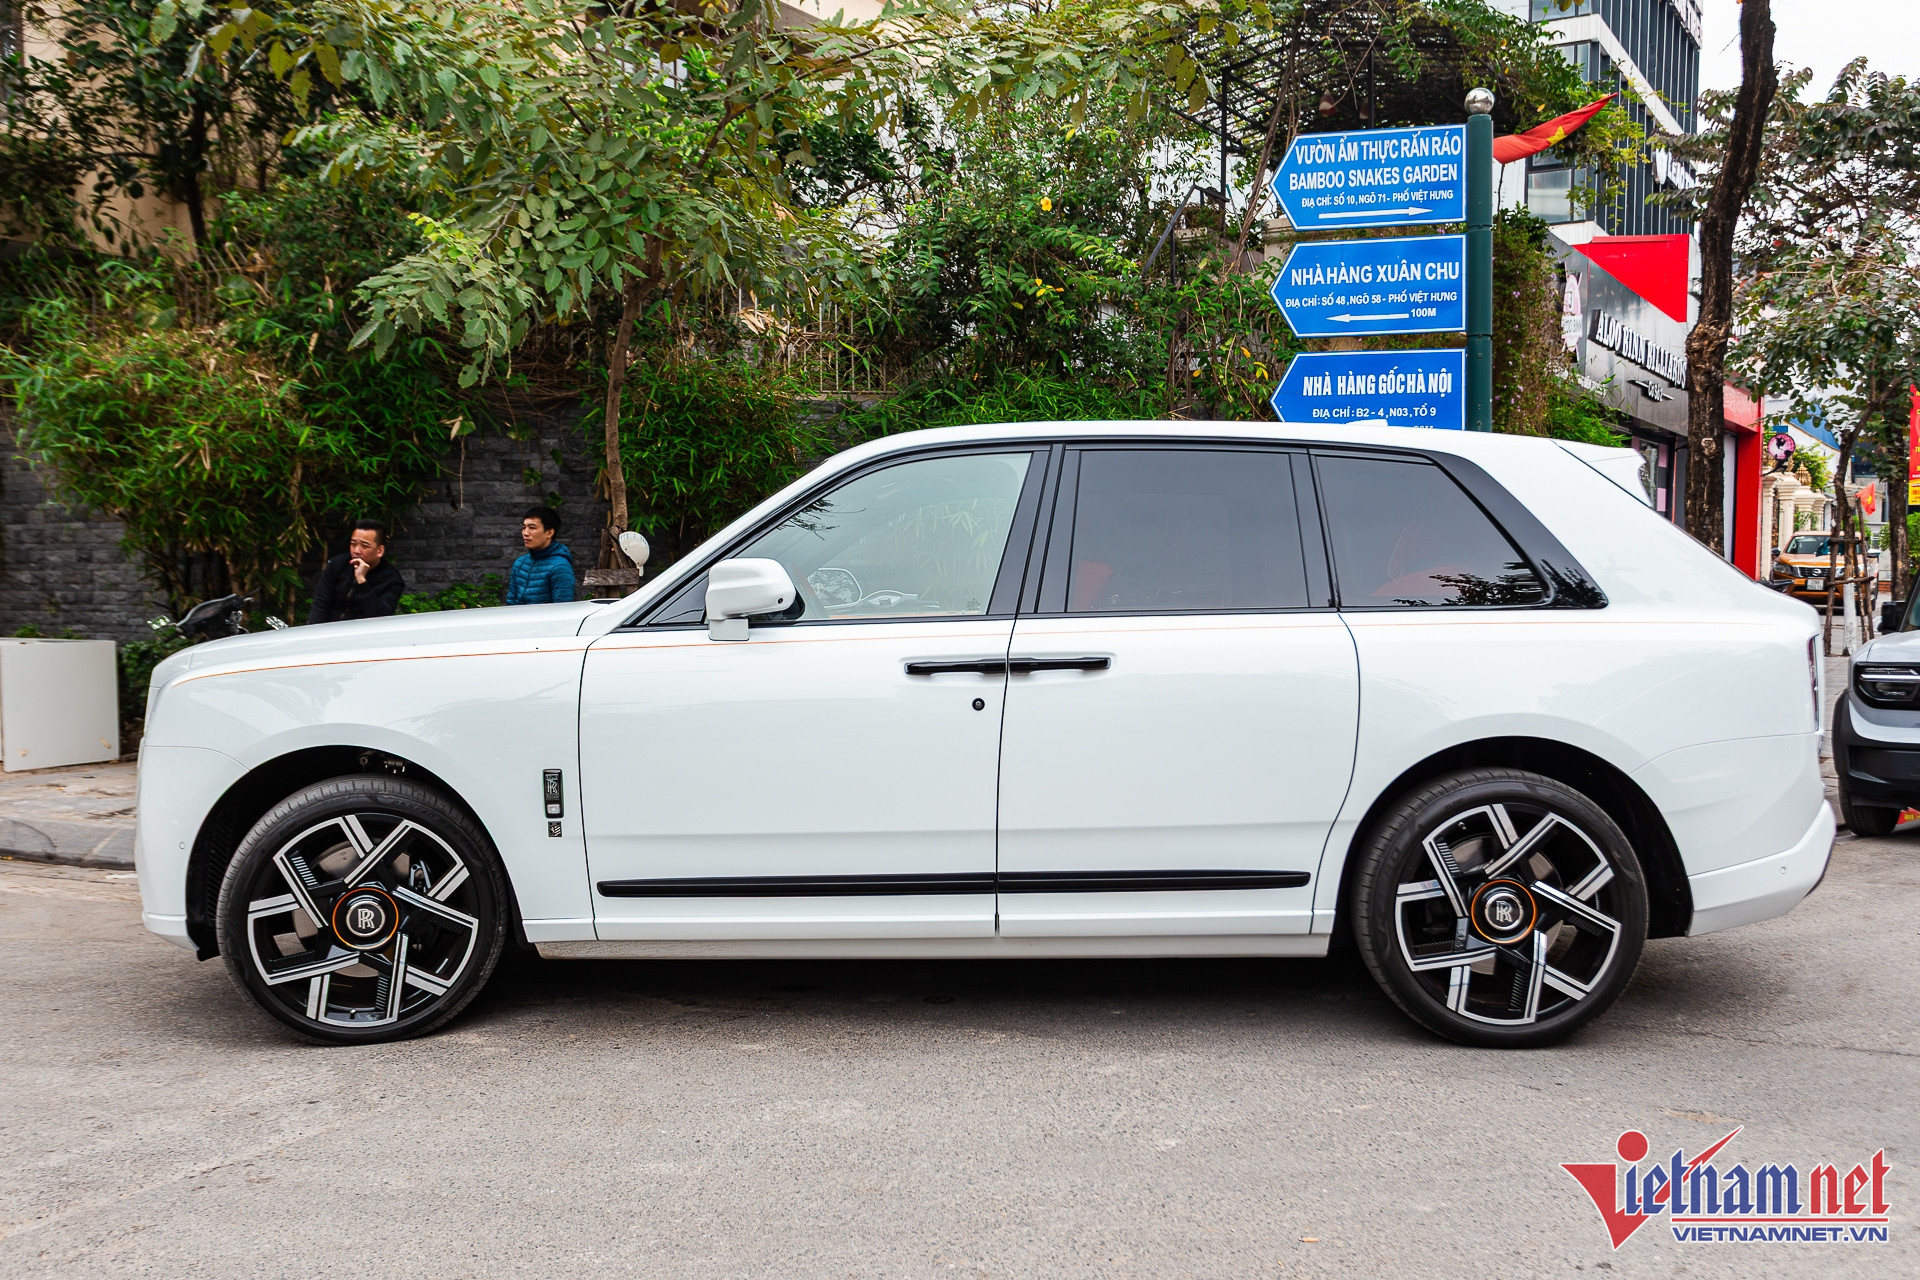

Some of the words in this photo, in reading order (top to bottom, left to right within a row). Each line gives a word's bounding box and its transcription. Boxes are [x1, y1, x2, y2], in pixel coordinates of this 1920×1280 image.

[1295, 139, 1335, 165] VƯỜN
[1338, 135, 1359, 162] ẨM
[1361, 139, 1399, 164] THỰC
[1401, 131, 1429, 158] RẮN
[1432, 131, 1461, 156] RÁO
[1289, 170, 1345, 191] BAMBOO
[1348, 166, 1400, 187] SNAKES
[1403, 163, 1458, 184] GARDEN
[1333, 191, 1345, 206] SỐ
[1392, 187, 1410, 202] PHỐ
[1411, 189, 1428, 203] VIỆT
[1429, 189, 1454, 200] HƯNG
[1291, 263, 1325, 286] NHÀ
[1326, 261, 1373, 285] HÀNG
[1376, 259, 1422, 283] XUÂN
[1424, 261, 1460, 281] CHU
[1321, 292, 1334, 306] SỐ
[1388, 289, 1407, 303] PHỐ
[1409, 290, 1429, 304] VIỆT
[1430, 291, 1457, 302] HƯNG
[1410, 307, 1437, 318] 100M
[1596, 310, 1622, 351] ALOO
[1622, 326, 1646, 364] BINN
[1646, 340, 1687, 389] BILLIARDS
[1303, 371, 1332, 396] NHÀ
[1337, 370, 1376, 396] HÀNG
[1378, 365, 1405, 395] GỐC
[1406, 368, 1426, 394] HÀ
[1427, 367, 1452, 398] NỘI
[1413, 403, 1428, 417] TỔ
[1429, 406, 1437, 417] 9
